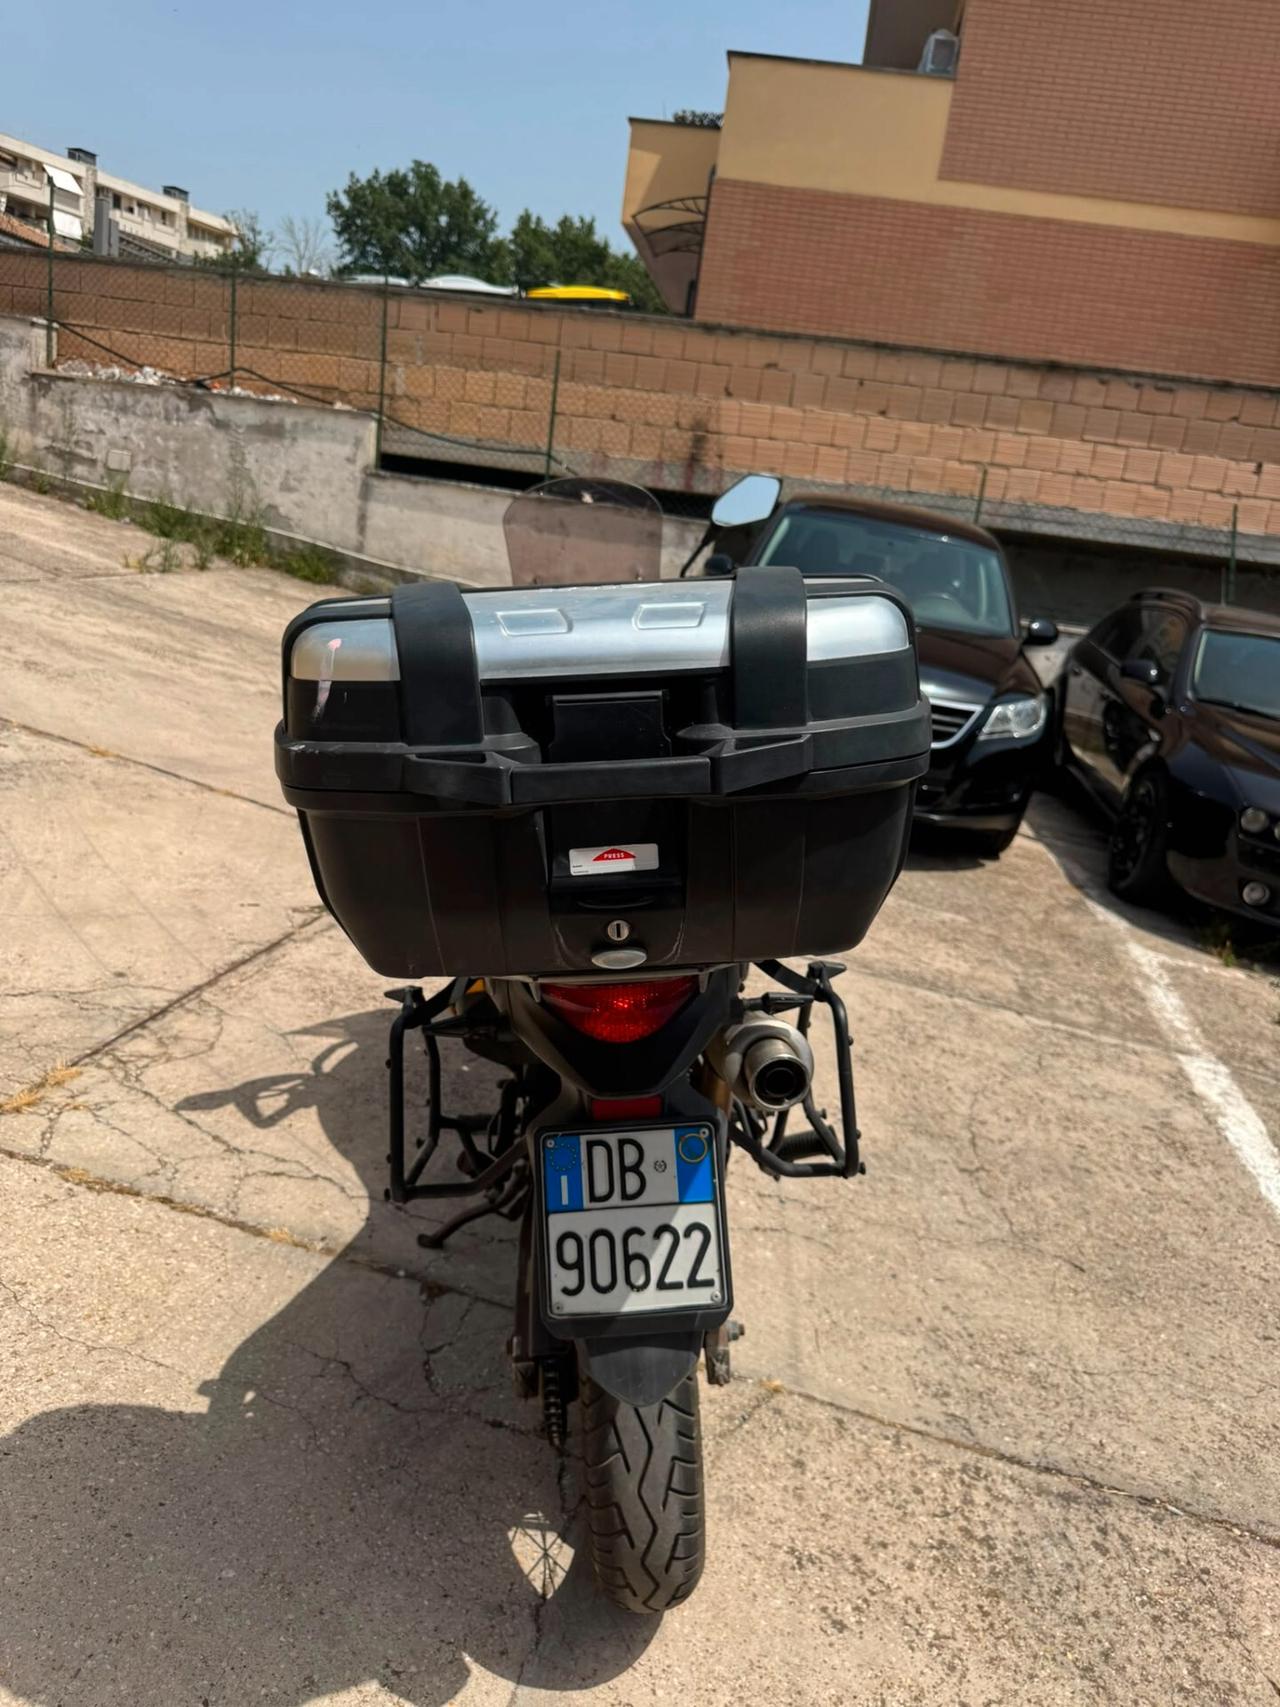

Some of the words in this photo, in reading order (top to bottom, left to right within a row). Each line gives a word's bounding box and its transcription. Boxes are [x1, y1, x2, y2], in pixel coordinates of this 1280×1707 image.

[560, 1175, 569, 1206] I
[586, 1138, 647, 1203] DB
[556, 1221, 716, 1297] 90622
